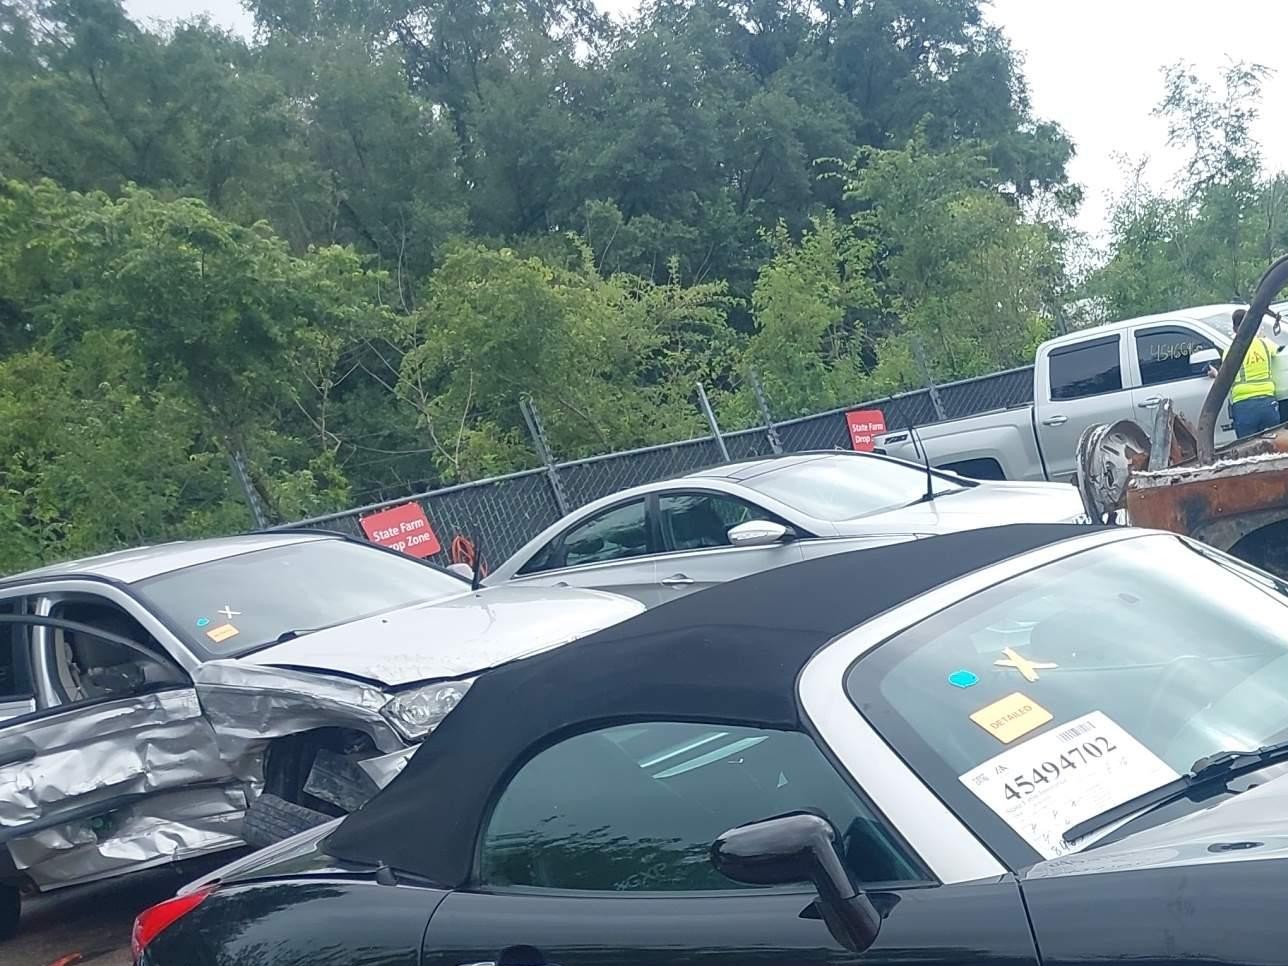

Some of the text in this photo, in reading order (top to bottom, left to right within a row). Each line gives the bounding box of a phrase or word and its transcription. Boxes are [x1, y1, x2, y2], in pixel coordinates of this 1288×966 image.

[852, 422, 884, 433] State Farm
[855, 435, 871, 444] Drop
[373, 519, 425, 542] State Farm
[406, 532, 431, 546] Zone
[990, 705, 1032, 729] DETAILED
[1004, 736, 1118, 800] 45494702
